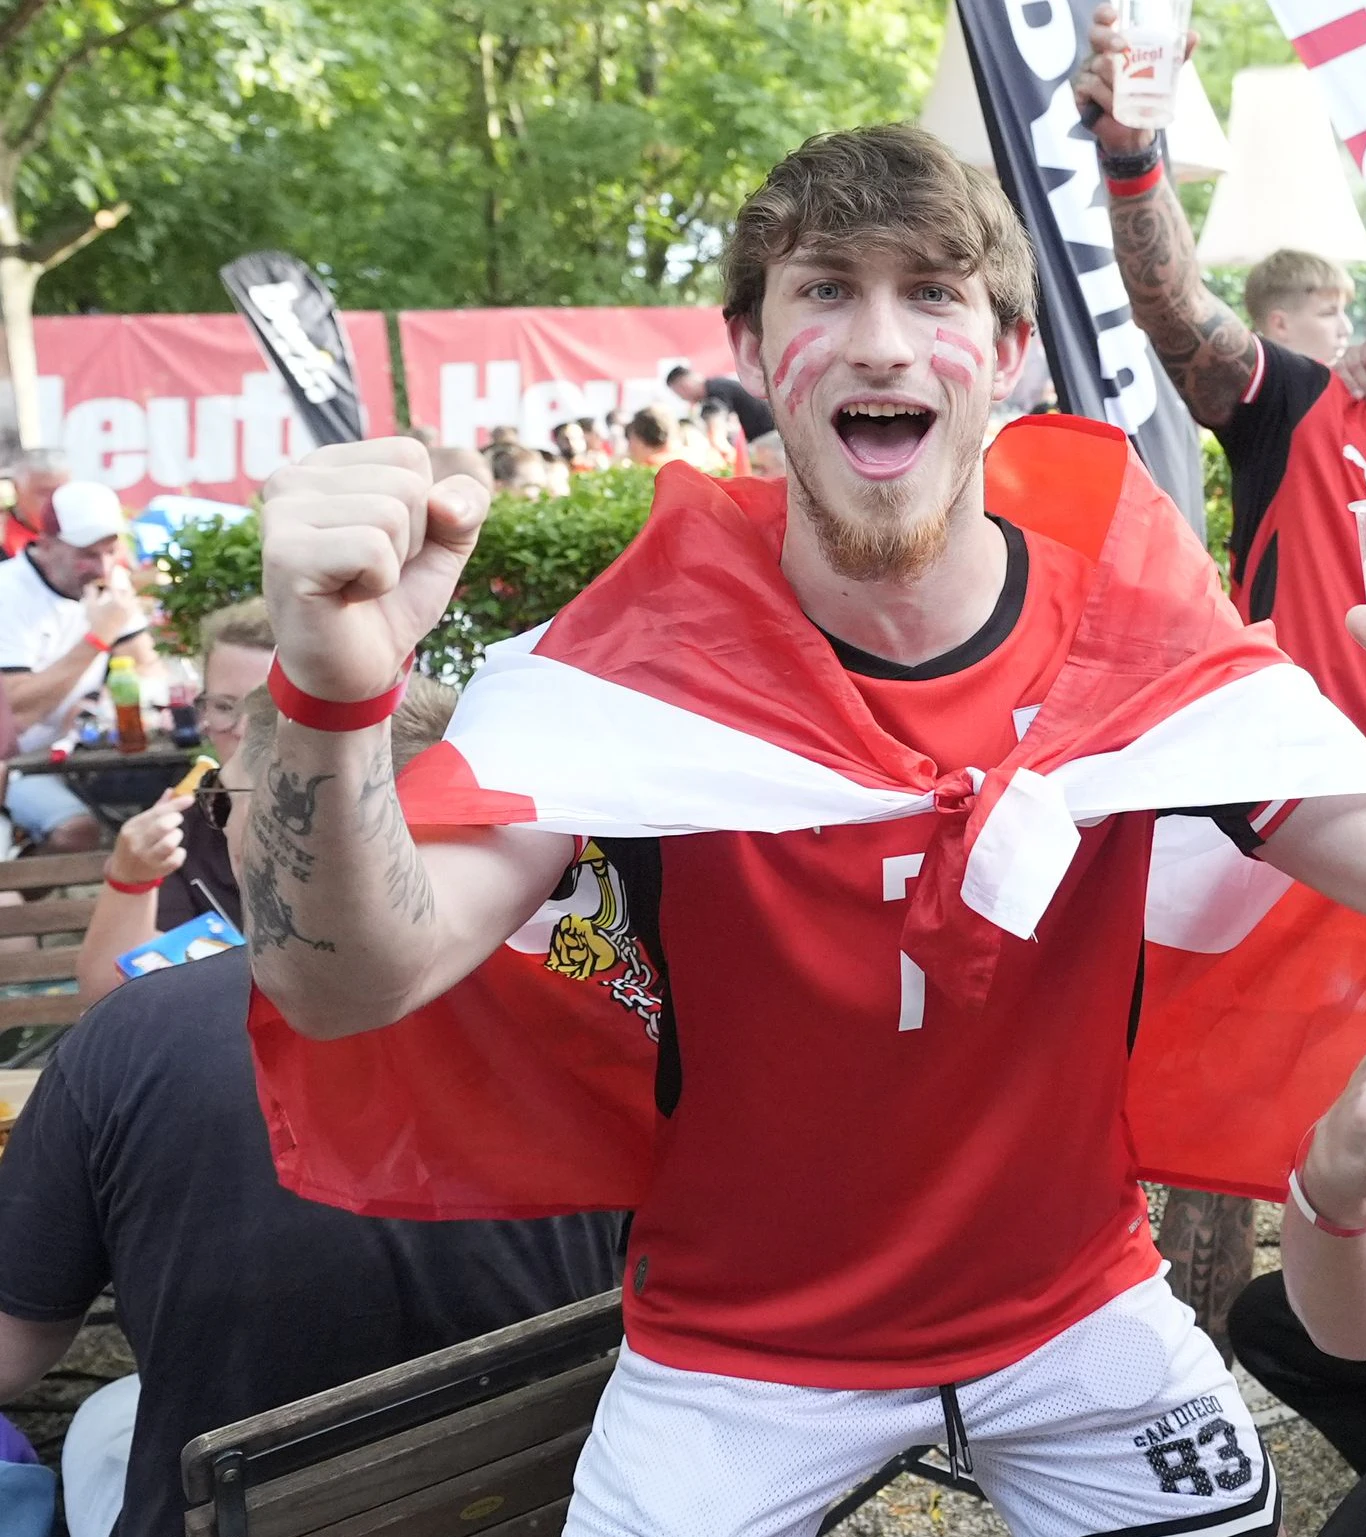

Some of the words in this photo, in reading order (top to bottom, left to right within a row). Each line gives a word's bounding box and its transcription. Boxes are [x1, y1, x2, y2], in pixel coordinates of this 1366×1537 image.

[1133, 1414, 1176, 1448] SAN
[1171, 1395, 1224, 1428] DIEGO
[1144, 1417, 1252, 1497] 83
